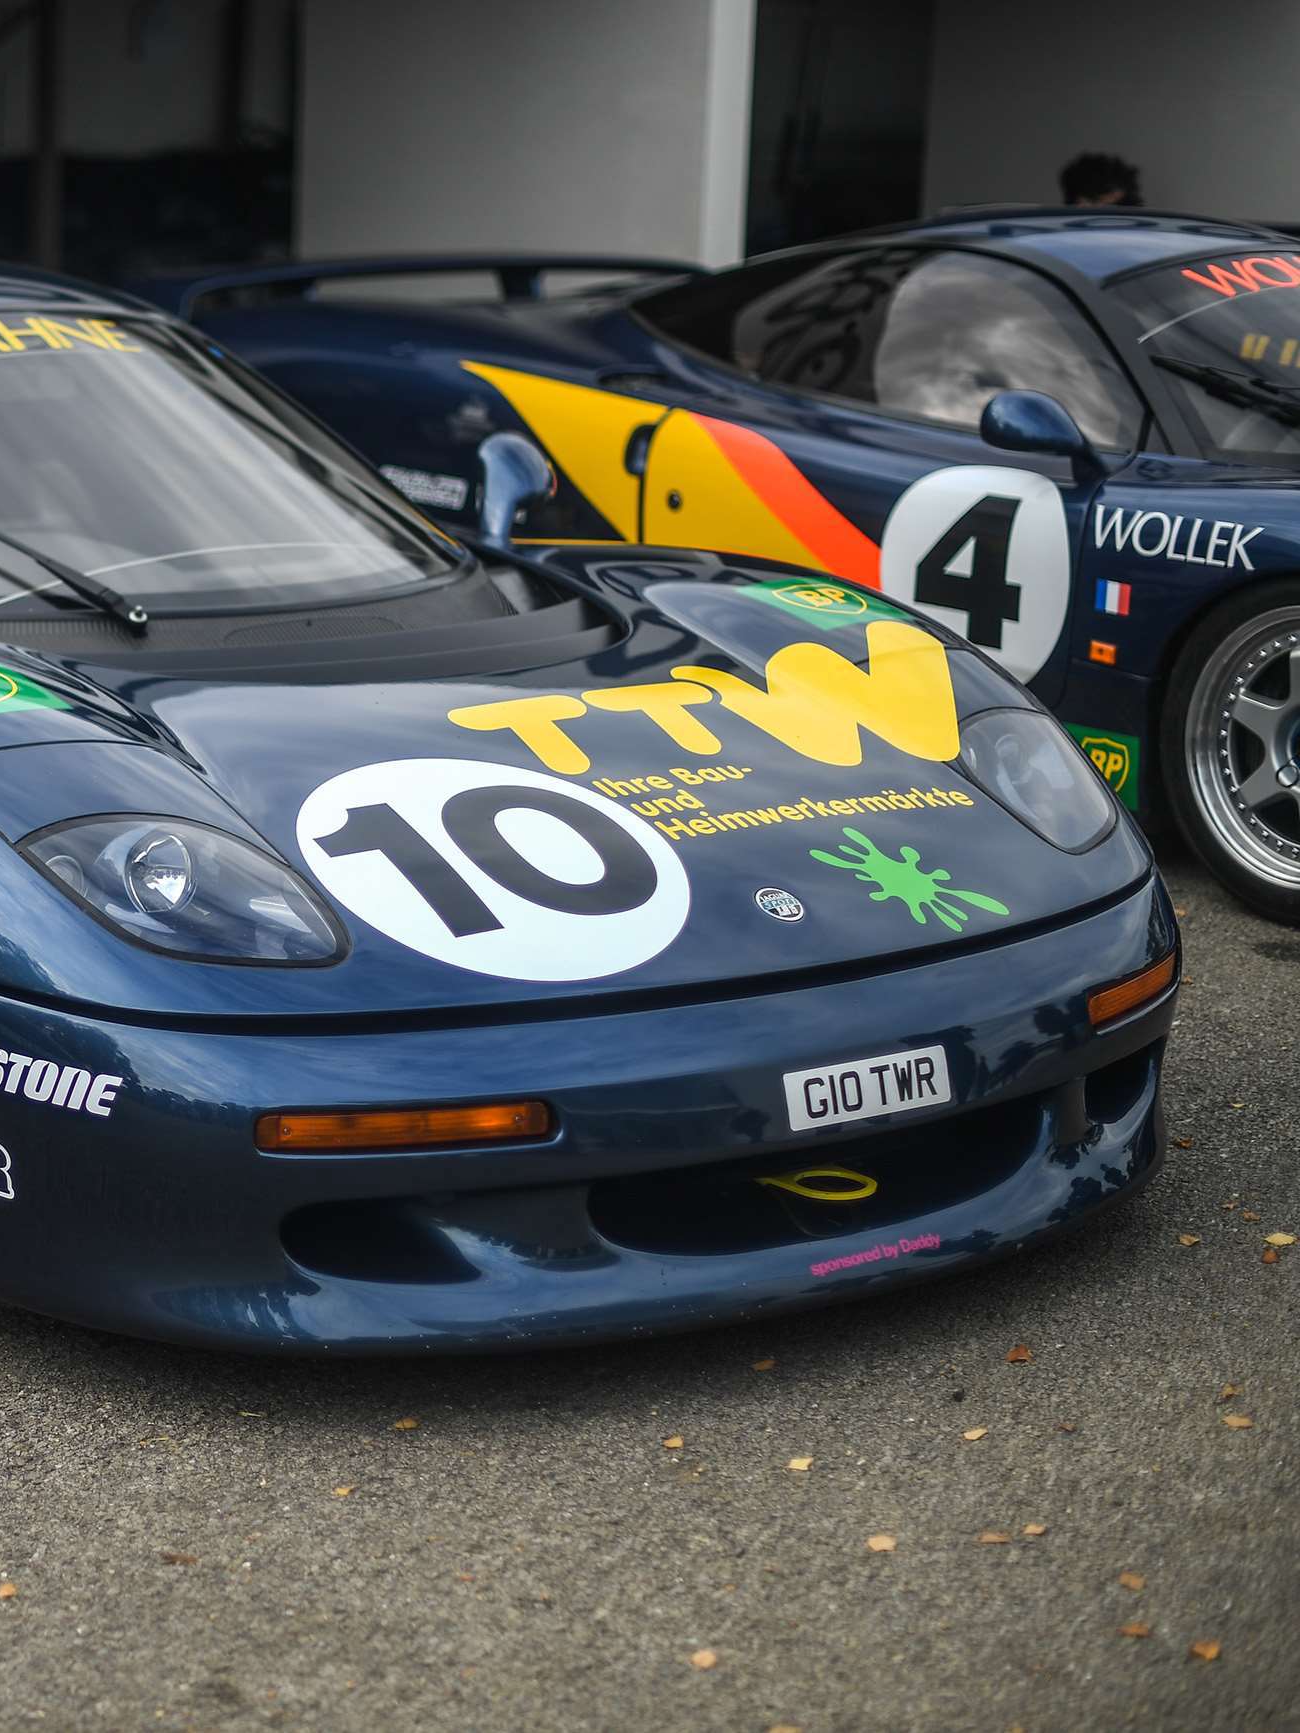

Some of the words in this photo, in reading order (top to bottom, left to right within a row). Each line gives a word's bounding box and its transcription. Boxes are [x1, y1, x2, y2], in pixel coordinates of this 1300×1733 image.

[1094, 504, 1266, 571] WOLLEK
[793, 587, 847, 608] BP
[913, 494, 1023, 650] 4
[447, 620, 962, 775] TTW
[592, 773, 672, 798] Ihre
[669, 765, 753, 786] Bau-
[631, 790, 704, 817] und
[654, 786, 975, 842] Heimwerkermärkte
[312, 784, 658, 939] 10
[803, 1070, 863, 1119] G10
[869, 1056, 938, 1106] TWR
[810, 1244, 881, 1277] sponsored
[883, 1243, 898, 1259] by
[898, 1233, 941, 1254] Daddy
